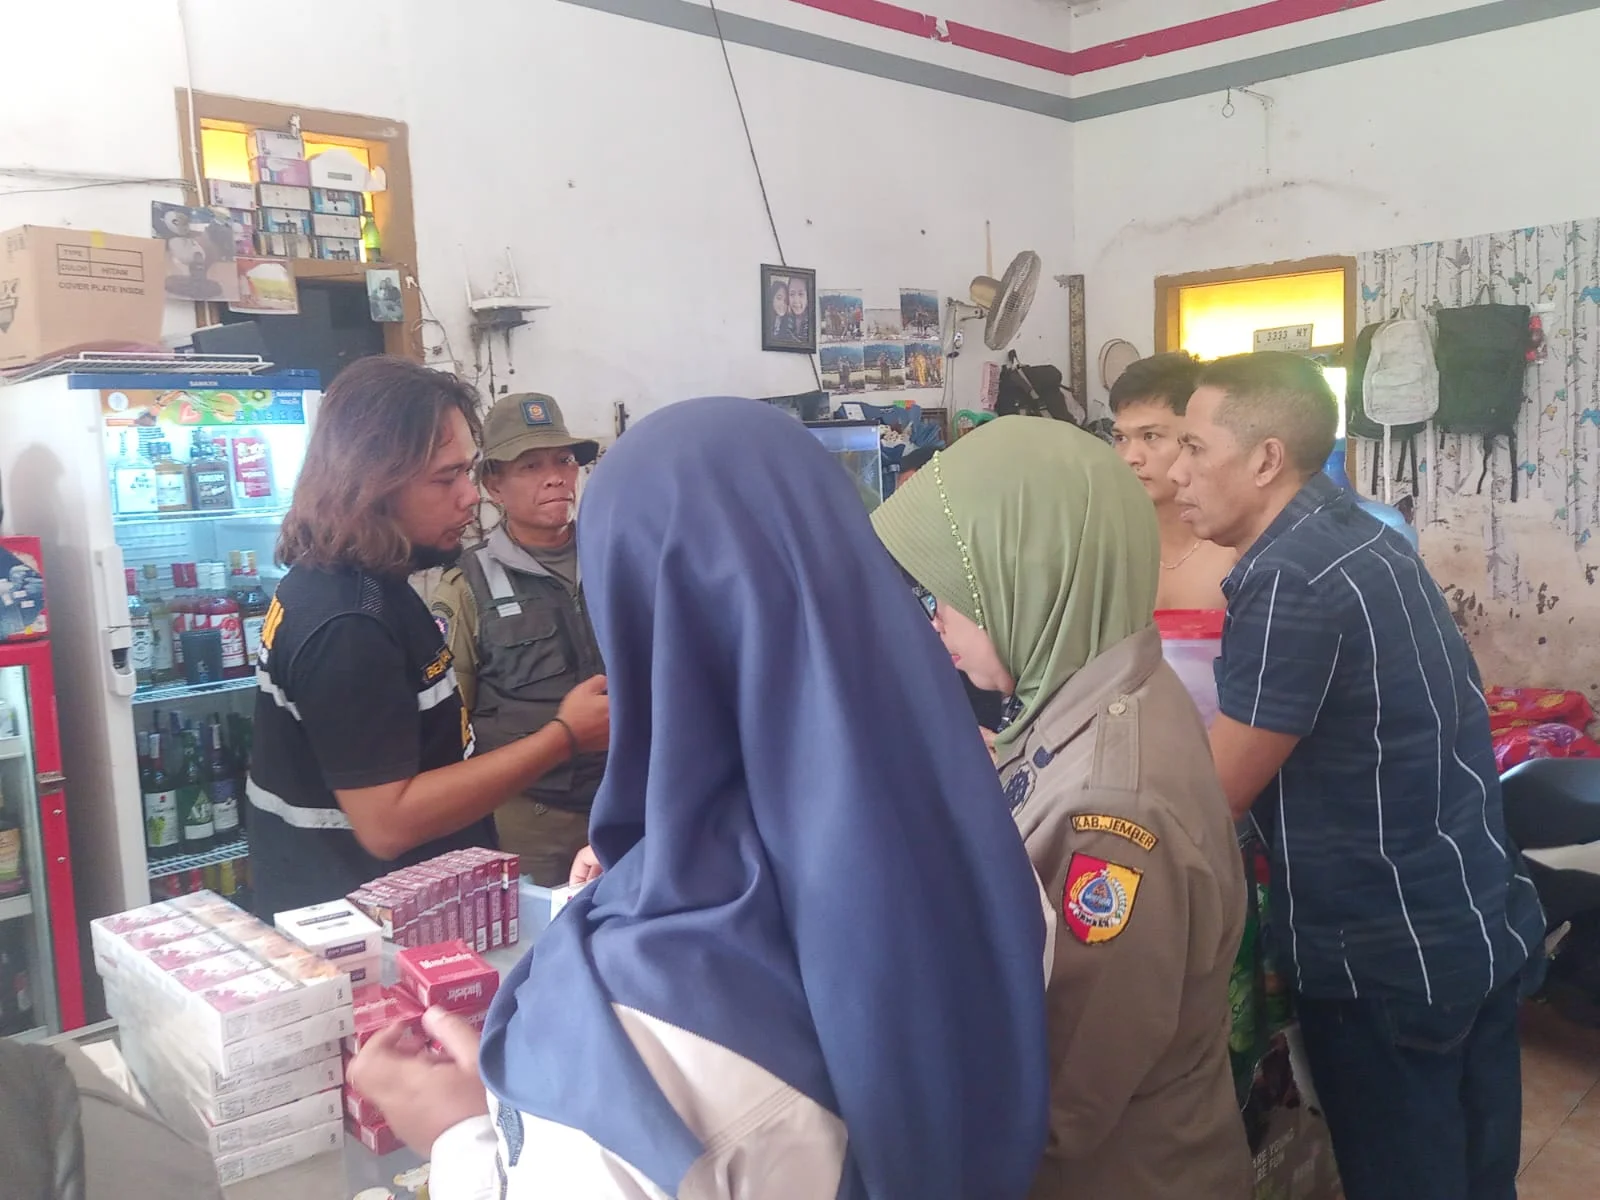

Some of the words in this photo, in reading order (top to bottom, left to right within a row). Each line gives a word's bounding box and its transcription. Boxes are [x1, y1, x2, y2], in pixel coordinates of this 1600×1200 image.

[59, 281, 90, 291] COVER
[91, 283, 118, 293] PLATE
[119, 286, 145, 296] INSIDE
[1105, 817, 1156, 849] JEMBER
